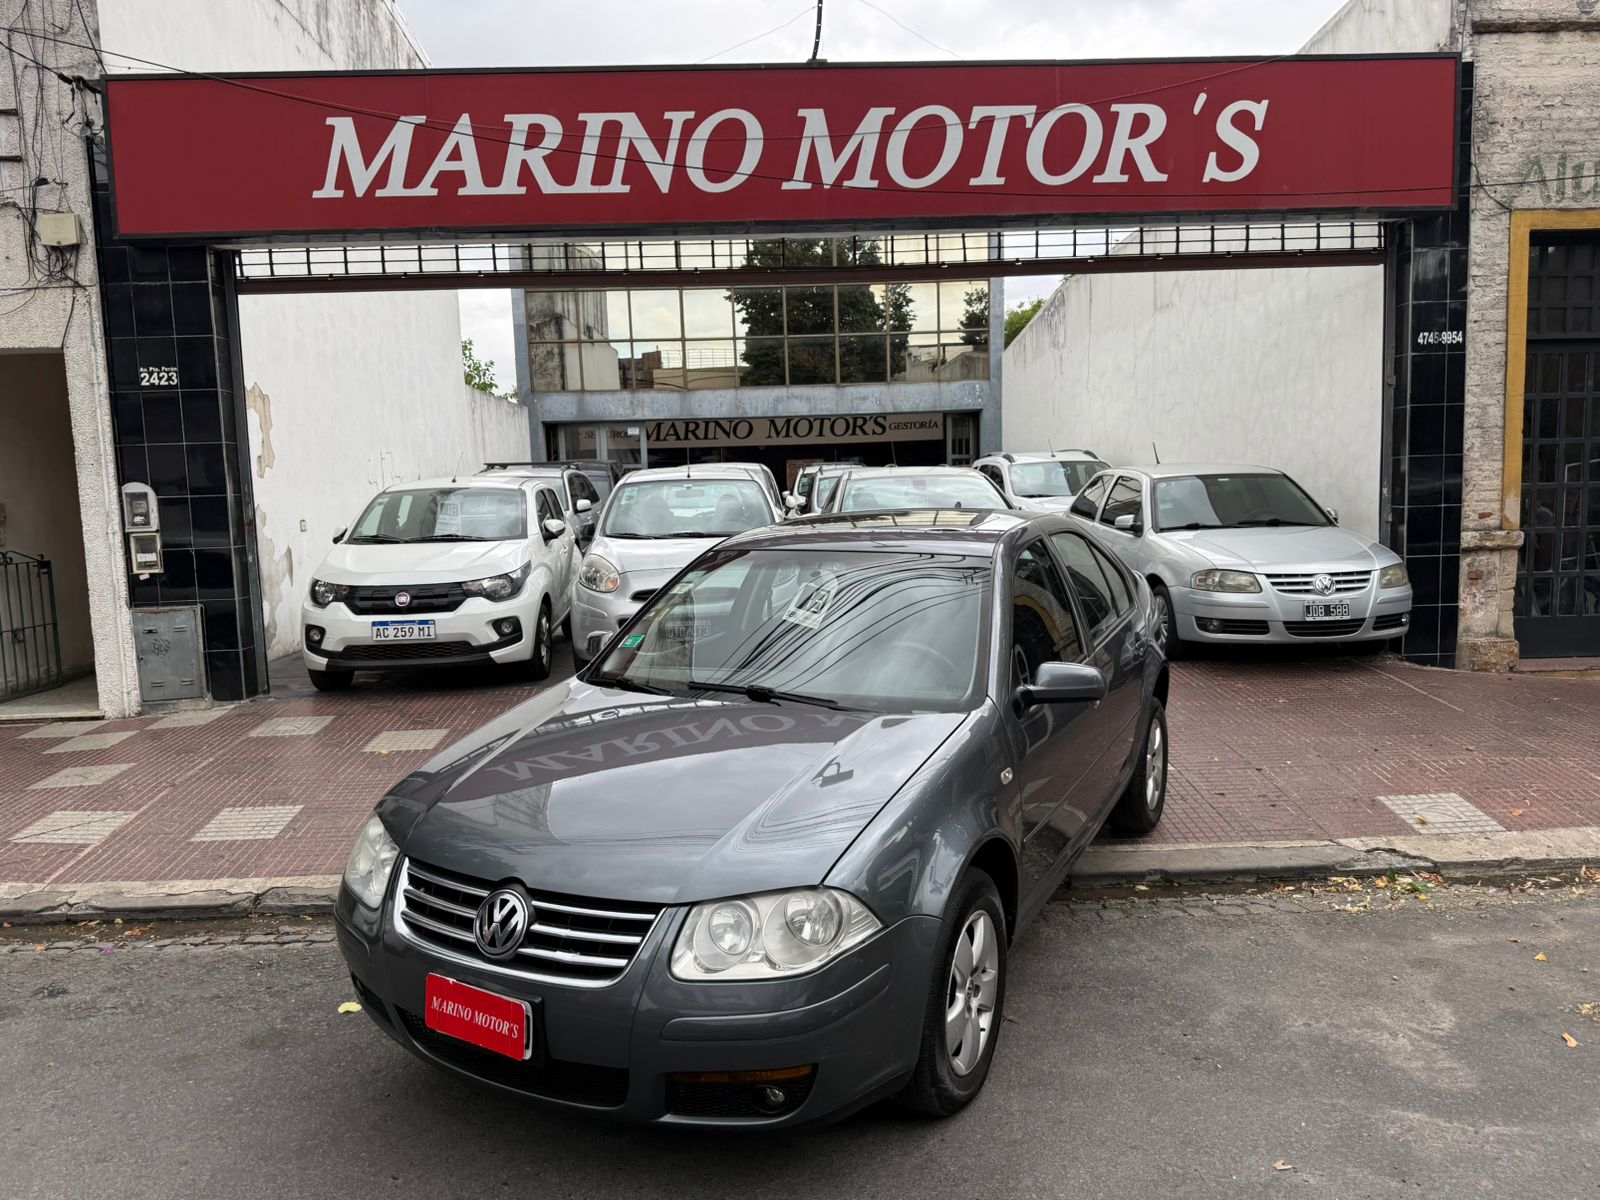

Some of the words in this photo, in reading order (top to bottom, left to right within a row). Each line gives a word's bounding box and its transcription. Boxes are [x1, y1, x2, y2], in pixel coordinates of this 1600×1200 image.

[312, 108, 764, 198] MARINO
[781, 92, 1269, 190] MOTOR'S
[140, 372, 178, 386] 2423
[637, 419, 754, 442] MARINO
[766, 415, 887, 439] MOTOR'S
[888, 418, 939, 432] GESTORÍA
[375, 627, 390, 639] AC
[393, 626, 414, 638] 259
[431, 995, 472, 1021] MARINO
[472, 1010, 519, 1039] MOTOR'S
